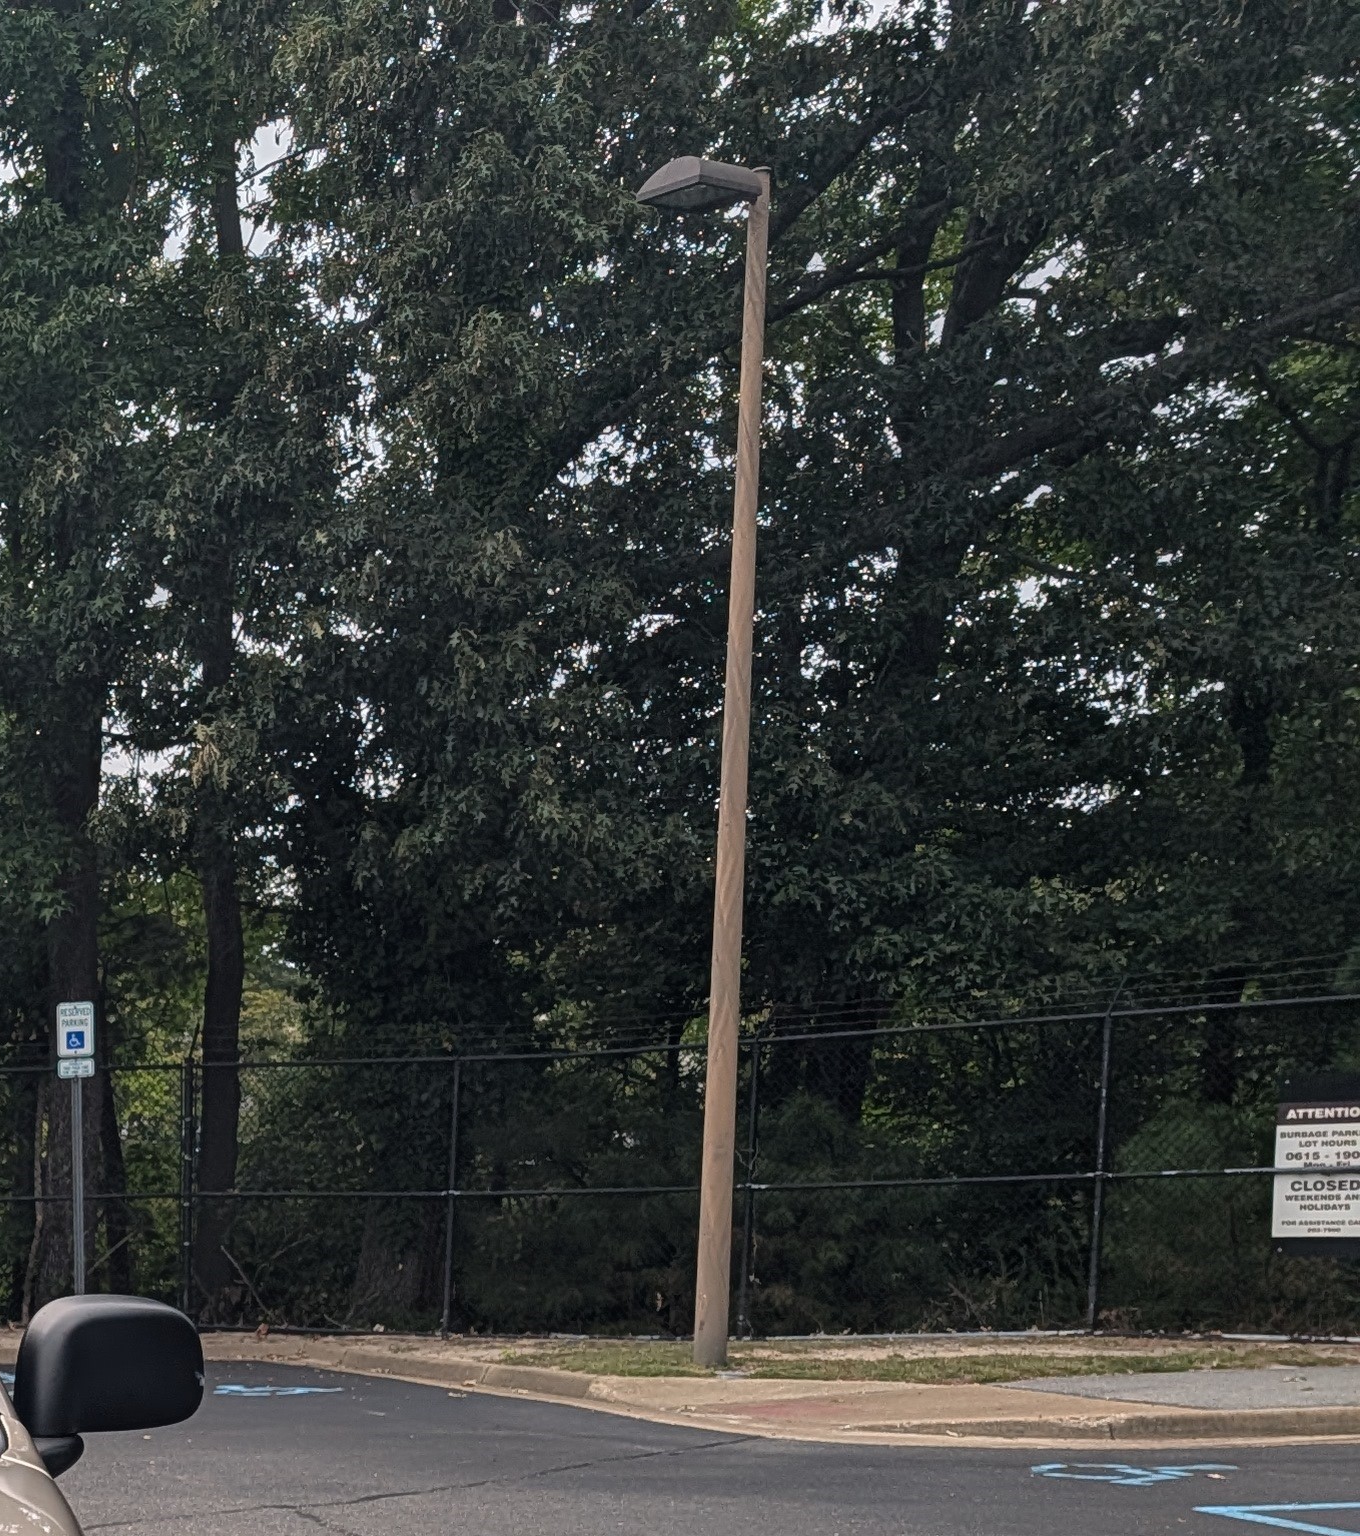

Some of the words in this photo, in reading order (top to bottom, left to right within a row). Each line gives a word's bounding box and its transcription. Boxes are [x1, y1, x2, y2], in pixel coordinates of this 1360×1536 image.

[1299, 1140, 1319, 1148] LOT
[1321, 1139, 1357, 1147] HOURS
[1286, 1151, 1320, 1161] 0615
[1290, 1180, 1360, 1192] CLOSED
[1285, 1194, 1341, 1202] WEEKENDS
[1344, 1193, 1360, 1201] AN
[1299, 1203, 1351, 1211] HOLIDAYS
